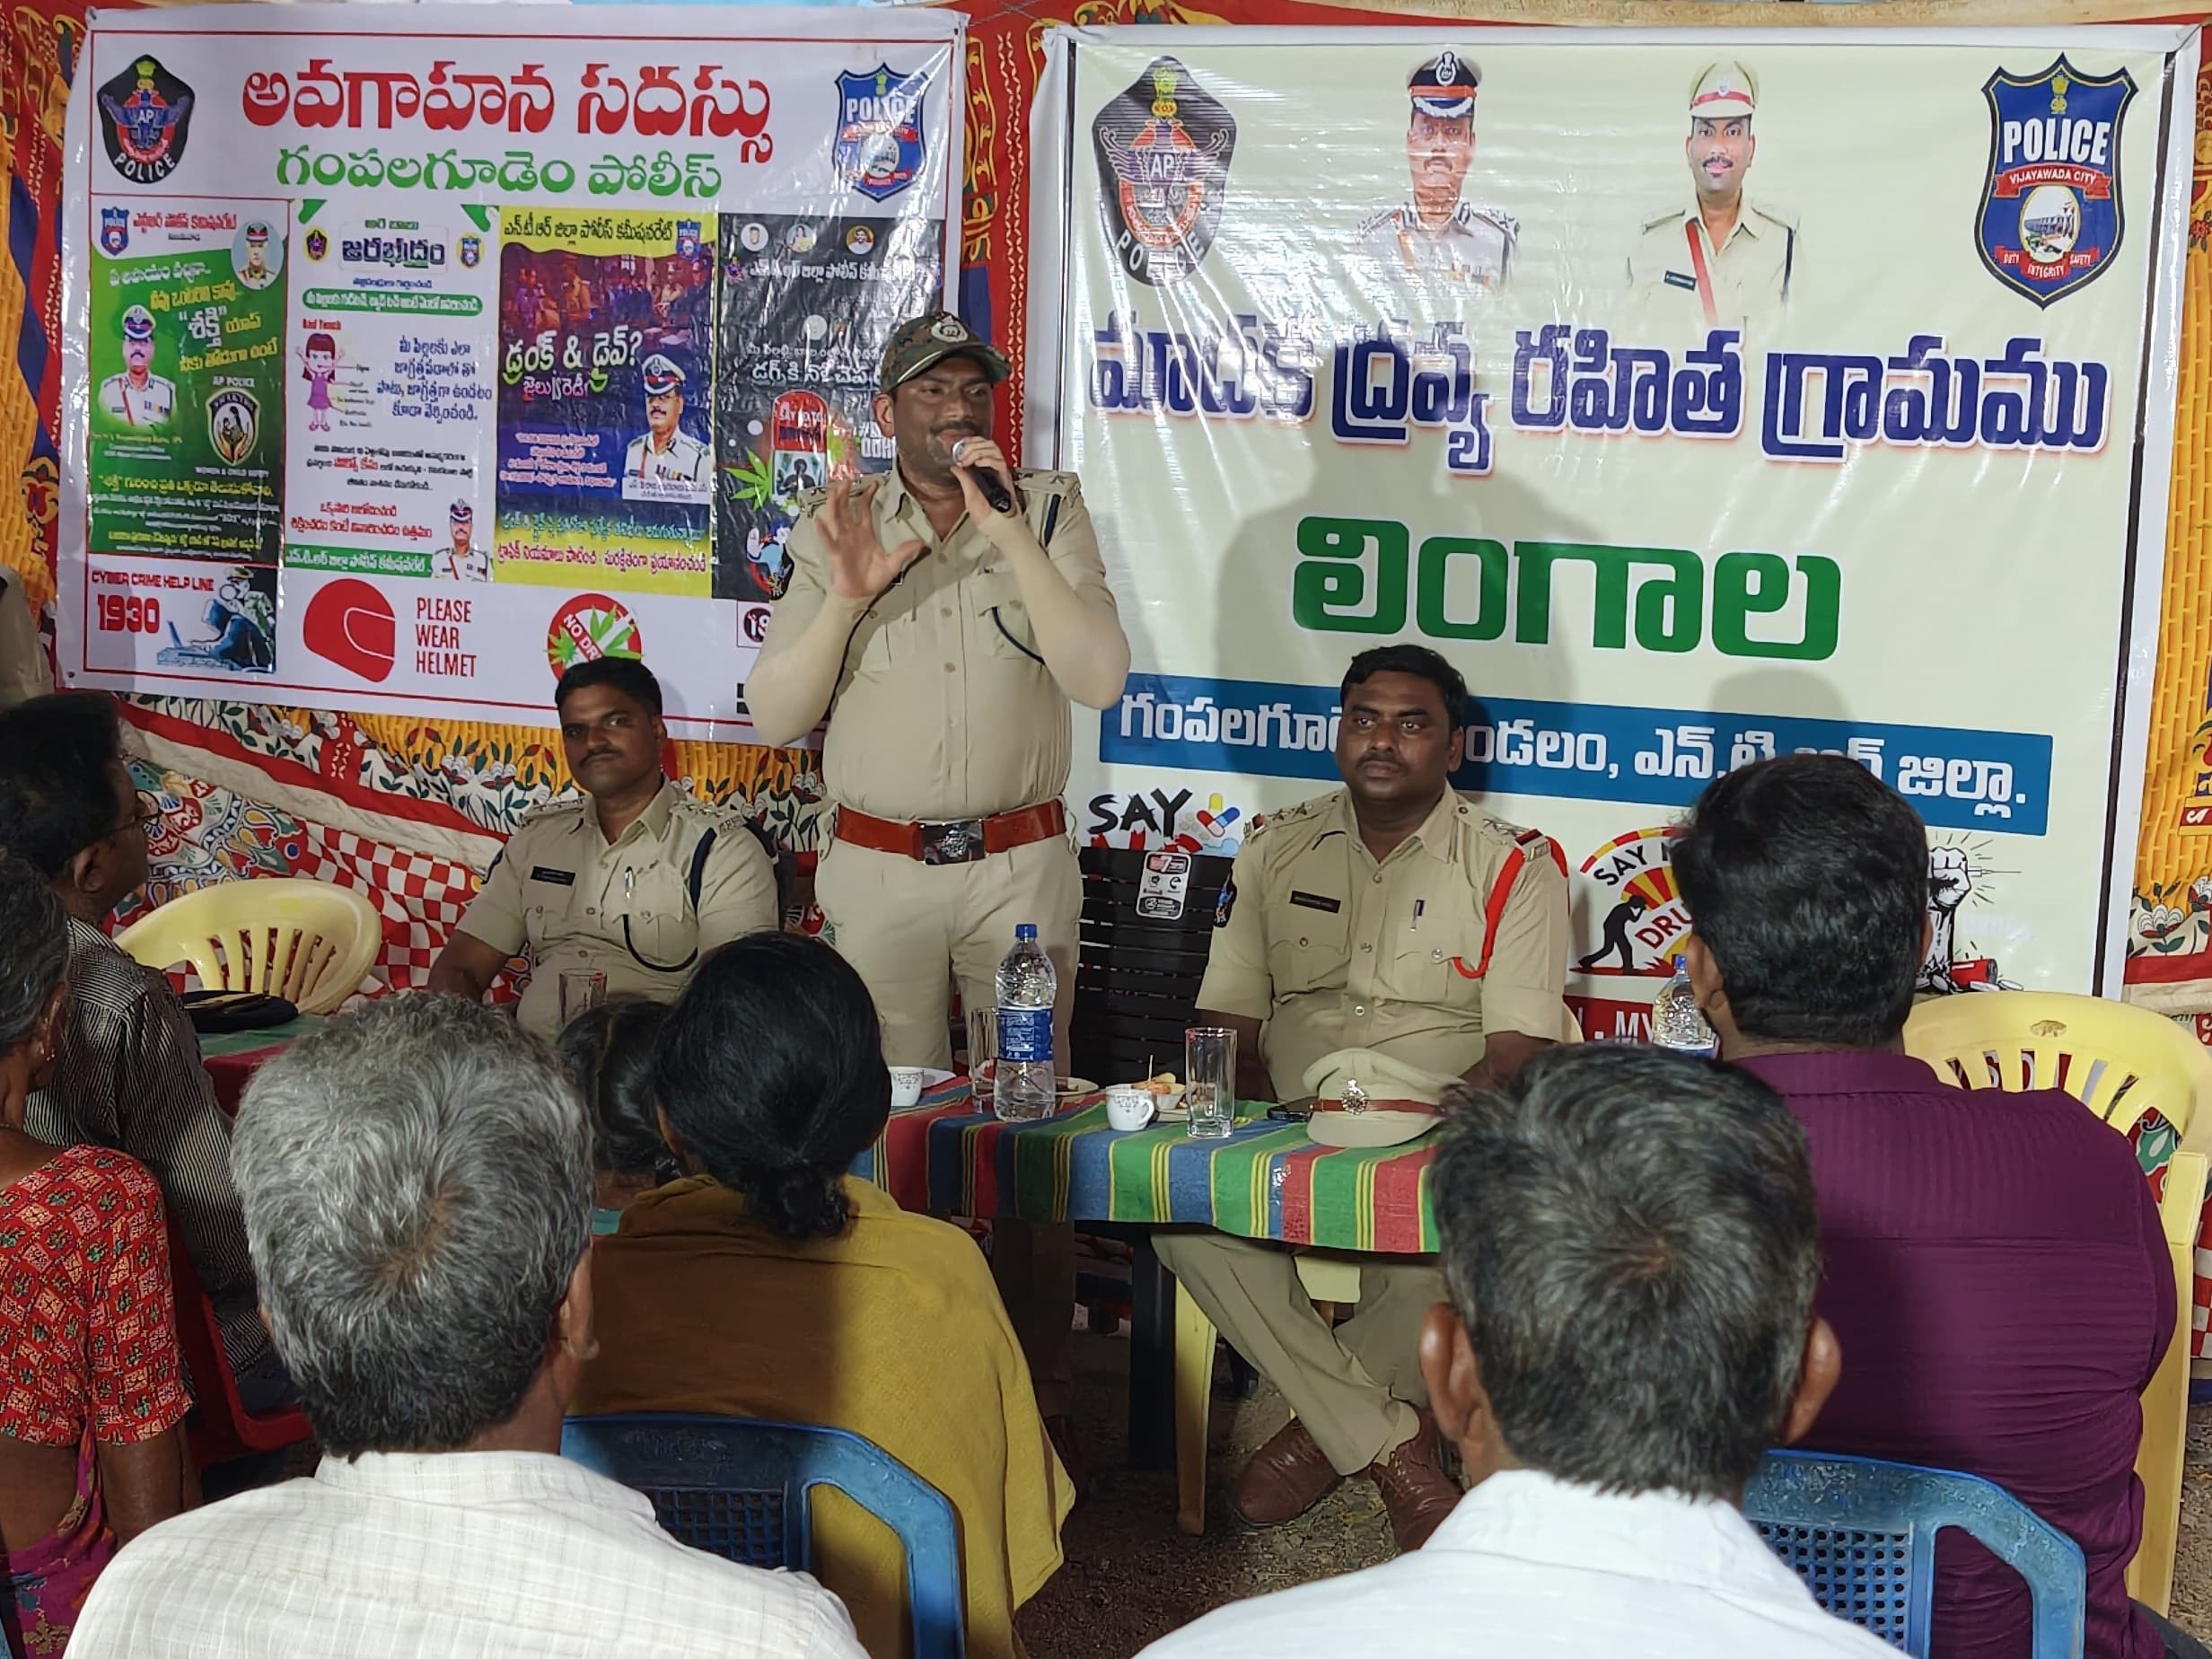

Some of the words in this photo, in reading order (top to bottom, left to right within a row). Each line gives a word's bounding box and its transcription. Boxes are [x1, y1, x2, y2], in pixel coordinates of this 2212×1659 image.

[137, 110, 154, 124] AP
[242, 59, 554, 133] అవగాహన
[577, 64, 773, 163] సదస్సు
[846, 95, 917, 124] POLICE
[2003, 118, 2111, 165] POLICE
[114, 152, 176, 181] POLICE
[276, 145, 575, 194] గంపలగూడెం
[588, 151, 722, 198] పోలీస్
[1151, 153, 1176, 179] AP
[2009, 168, 2071, 185] VIJAYAWADA
[2074, 171, 2097, 184] CITY
[1114, 230, 1207, 280] POCE
[563, 335, 583, 369] &
[1091, 310, 1315, 422] మాదక
[1331, 319, 1494, 475] ద్రవ్య
[1512, 324, 1743, 437] రహిత
[1762, 334, 2111, 463] గ్రామము
[92, 570, 129, 585] CYBER
[131, 573, 162, 588] CRIME
[162, 575, 190, 589] HELP
[191, 577, 215, 592] LINE
[1293, 516, 1842, 661] లింగాల
[98, 593, 160, 634] 1930
[416, 597, 473, 624] PLEASE
[563, 614, 584, 637] NO
[415, 623, 460, 650] WEAR
[415, 650, 478, 679] HELMET
[1465, 718, 1620, 779] ండలం,
[1897, 755, 2027, 819] జిల్లా.
[1088, 787, 1193, 840] SAY
[1593, 846, 1648, 887] SAY
